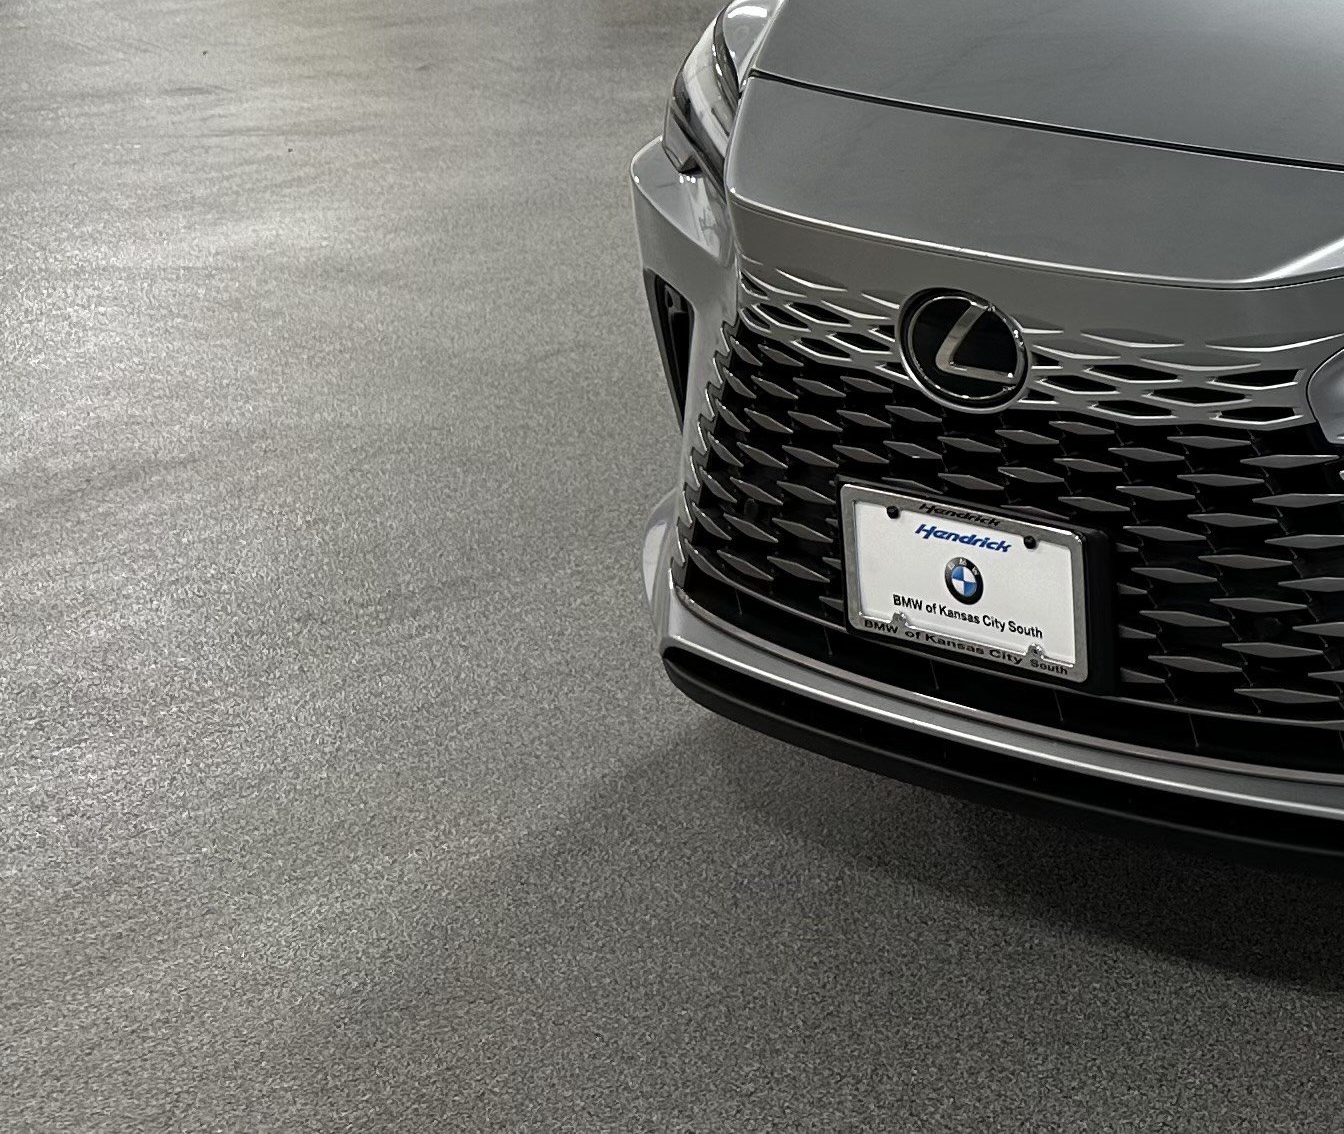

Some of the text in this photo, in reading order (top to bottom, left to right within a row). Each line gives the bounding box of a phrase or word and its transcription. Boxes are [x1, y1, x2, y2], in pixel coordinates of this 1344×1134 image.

[919, 503, 1001, 527] Hendrick
[915, 523, 1012, 553] Hendrick
[893, 594, 1043, 639] BMW of Kansas City South
[864, 619, 1069, 675] BMW of Kansas City South
